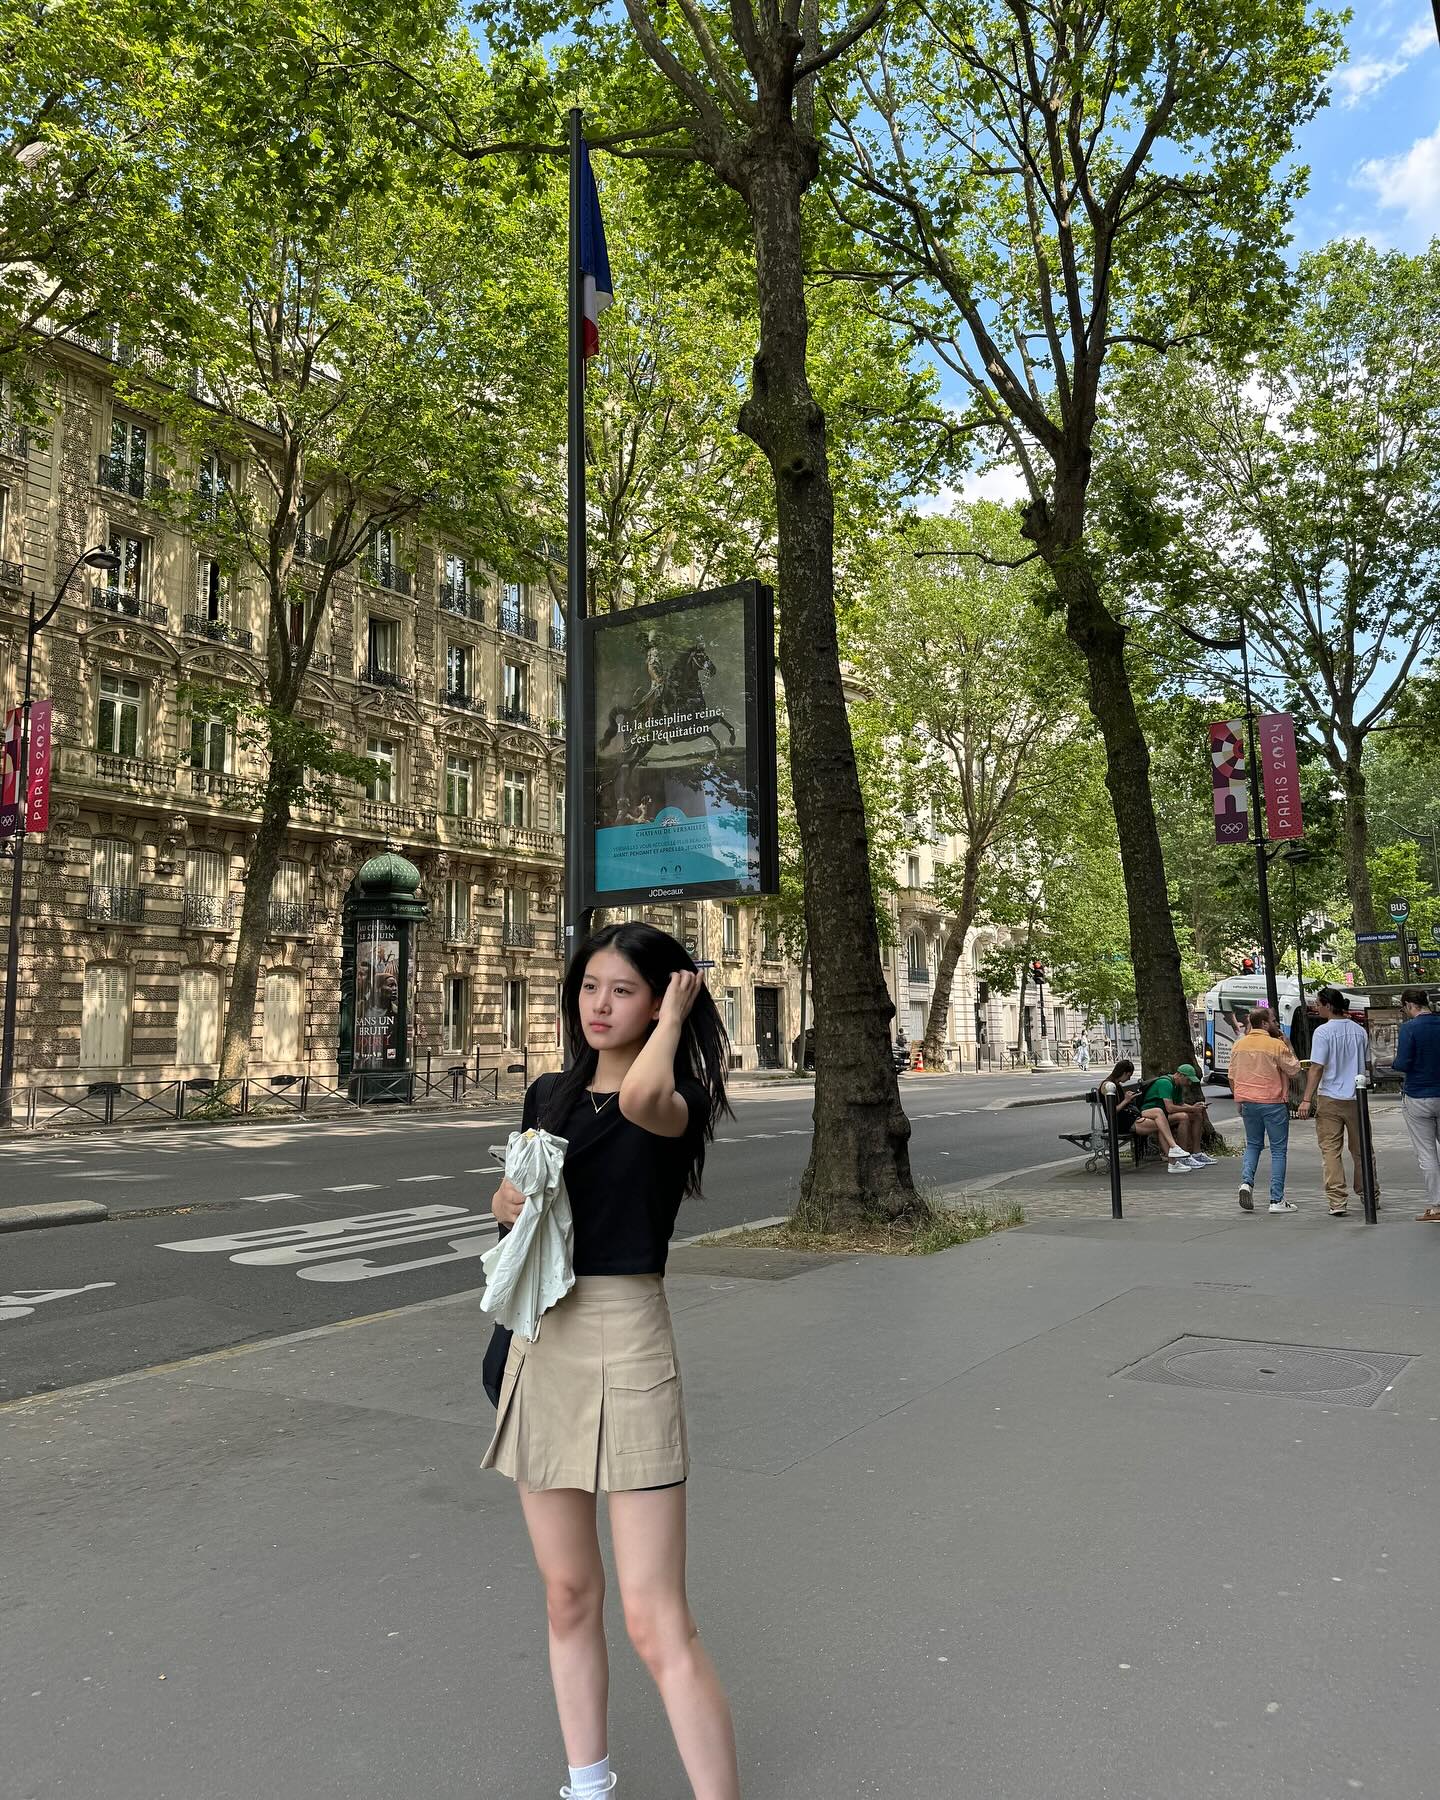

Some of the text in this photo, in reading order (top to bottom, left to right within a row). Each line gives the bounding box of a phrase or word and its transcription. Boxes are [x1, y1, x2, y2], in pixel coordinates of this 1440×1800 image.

[617, 707, 725, 733] Ici, la discipline reine,
[630, 723, 710, 745] c'est l'équitation
[33, 711, 46, 821] PARIS 2024
[1270, 723, 1292, 828] PARIS 2024
[673, 824, 706, 833] VERSAILLES
[648, 888, 684, 898] JCDecaux
[1390, 902, 1407, 912] BUS
[356, 1016, 395, 1026] SANS UN
[359, 1026, 389, 1035] BRUIT
[154, 1204, 501, 1283] BUS
